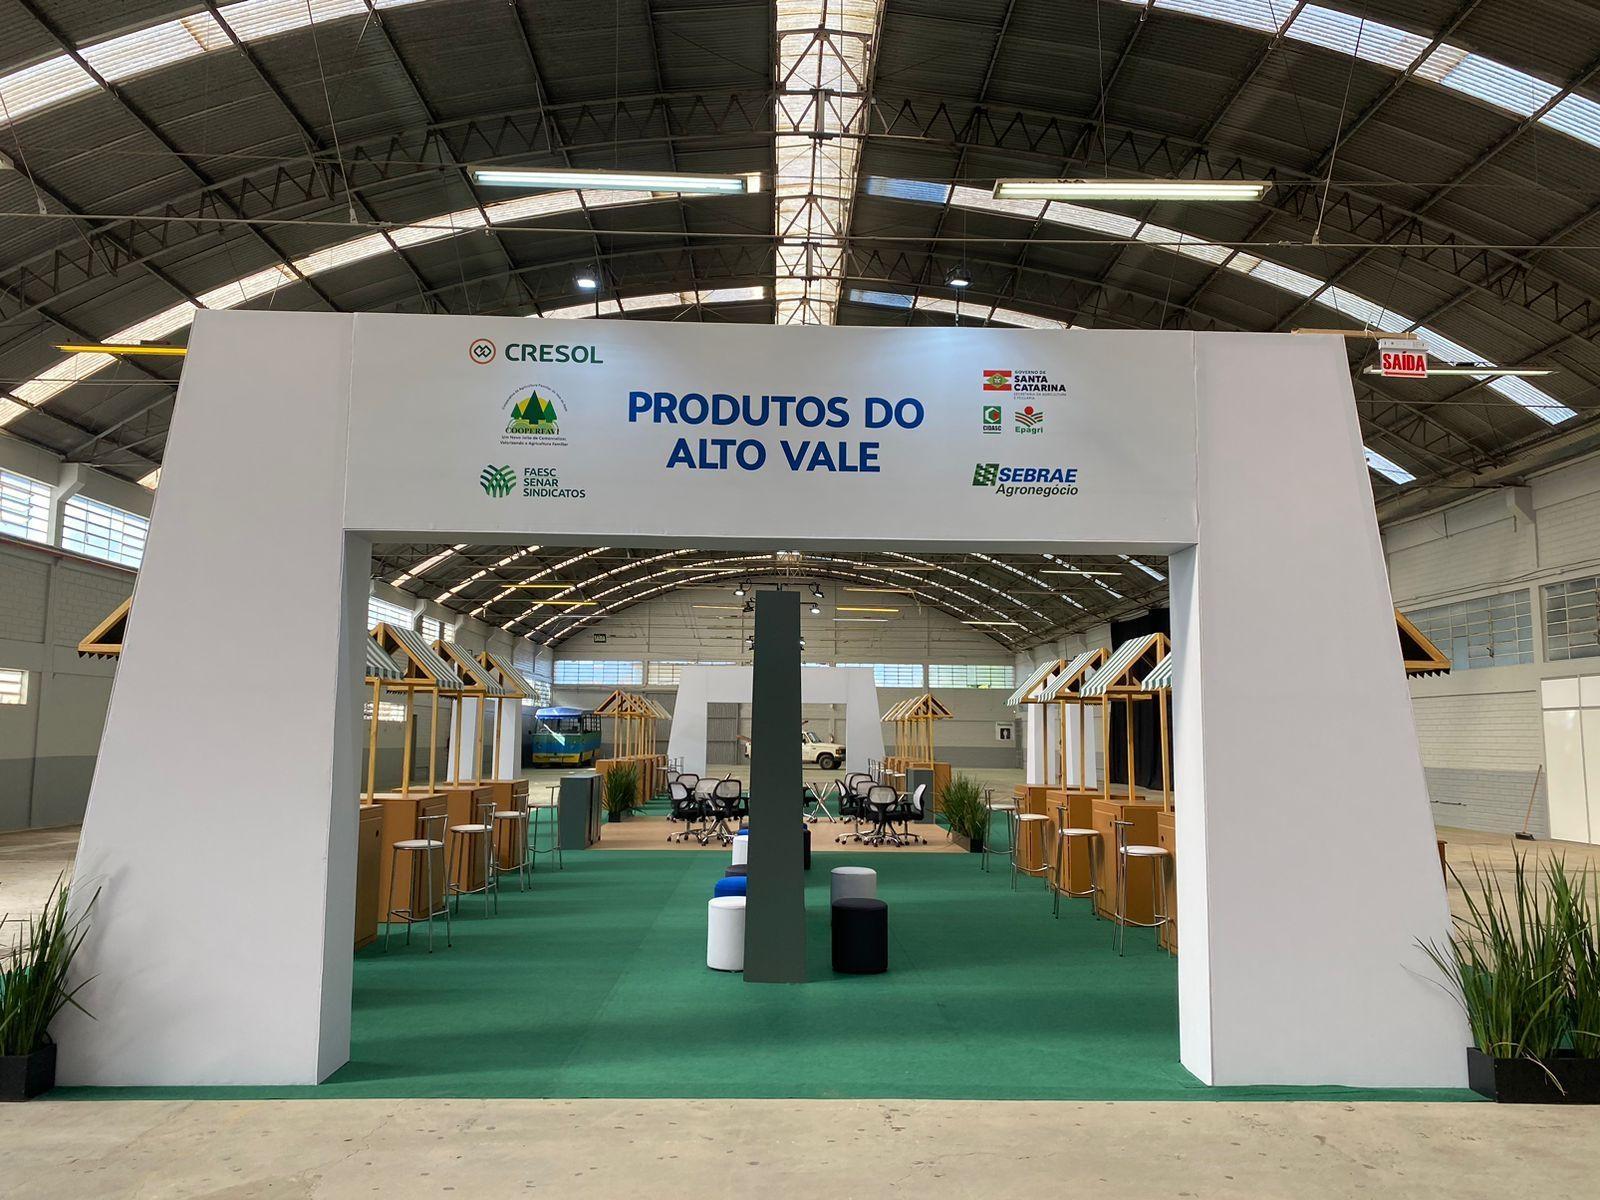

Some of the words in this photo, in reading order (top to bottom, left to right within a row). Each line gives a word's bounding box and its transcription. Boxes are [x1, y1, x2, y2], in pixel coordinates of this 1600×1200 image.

[504, 343, 604, 364] CRESOL
[1382, 351, 1426, 372] SAÍDA
[1014, 375, 1048, 383] SANTA
[1013, 384, 1067, 392] CATARINA
[628, 391, 850, 428] PRODUTOS
[864, 397, 925, 430] DO
[1014, 426, 1044, 434] Epagri
[666, 437, 767, 471] ALTO
[780, 440, 881, 473] VALE
[524, 467, 557, 477] FAESC
[998, 467, 1078, 483] SEBRAE
[523, 478, 559, 487] SENAR
[523, 488, 586, 498] SINDICATOS
[996, 483, 1079, 497] Agronegócio
